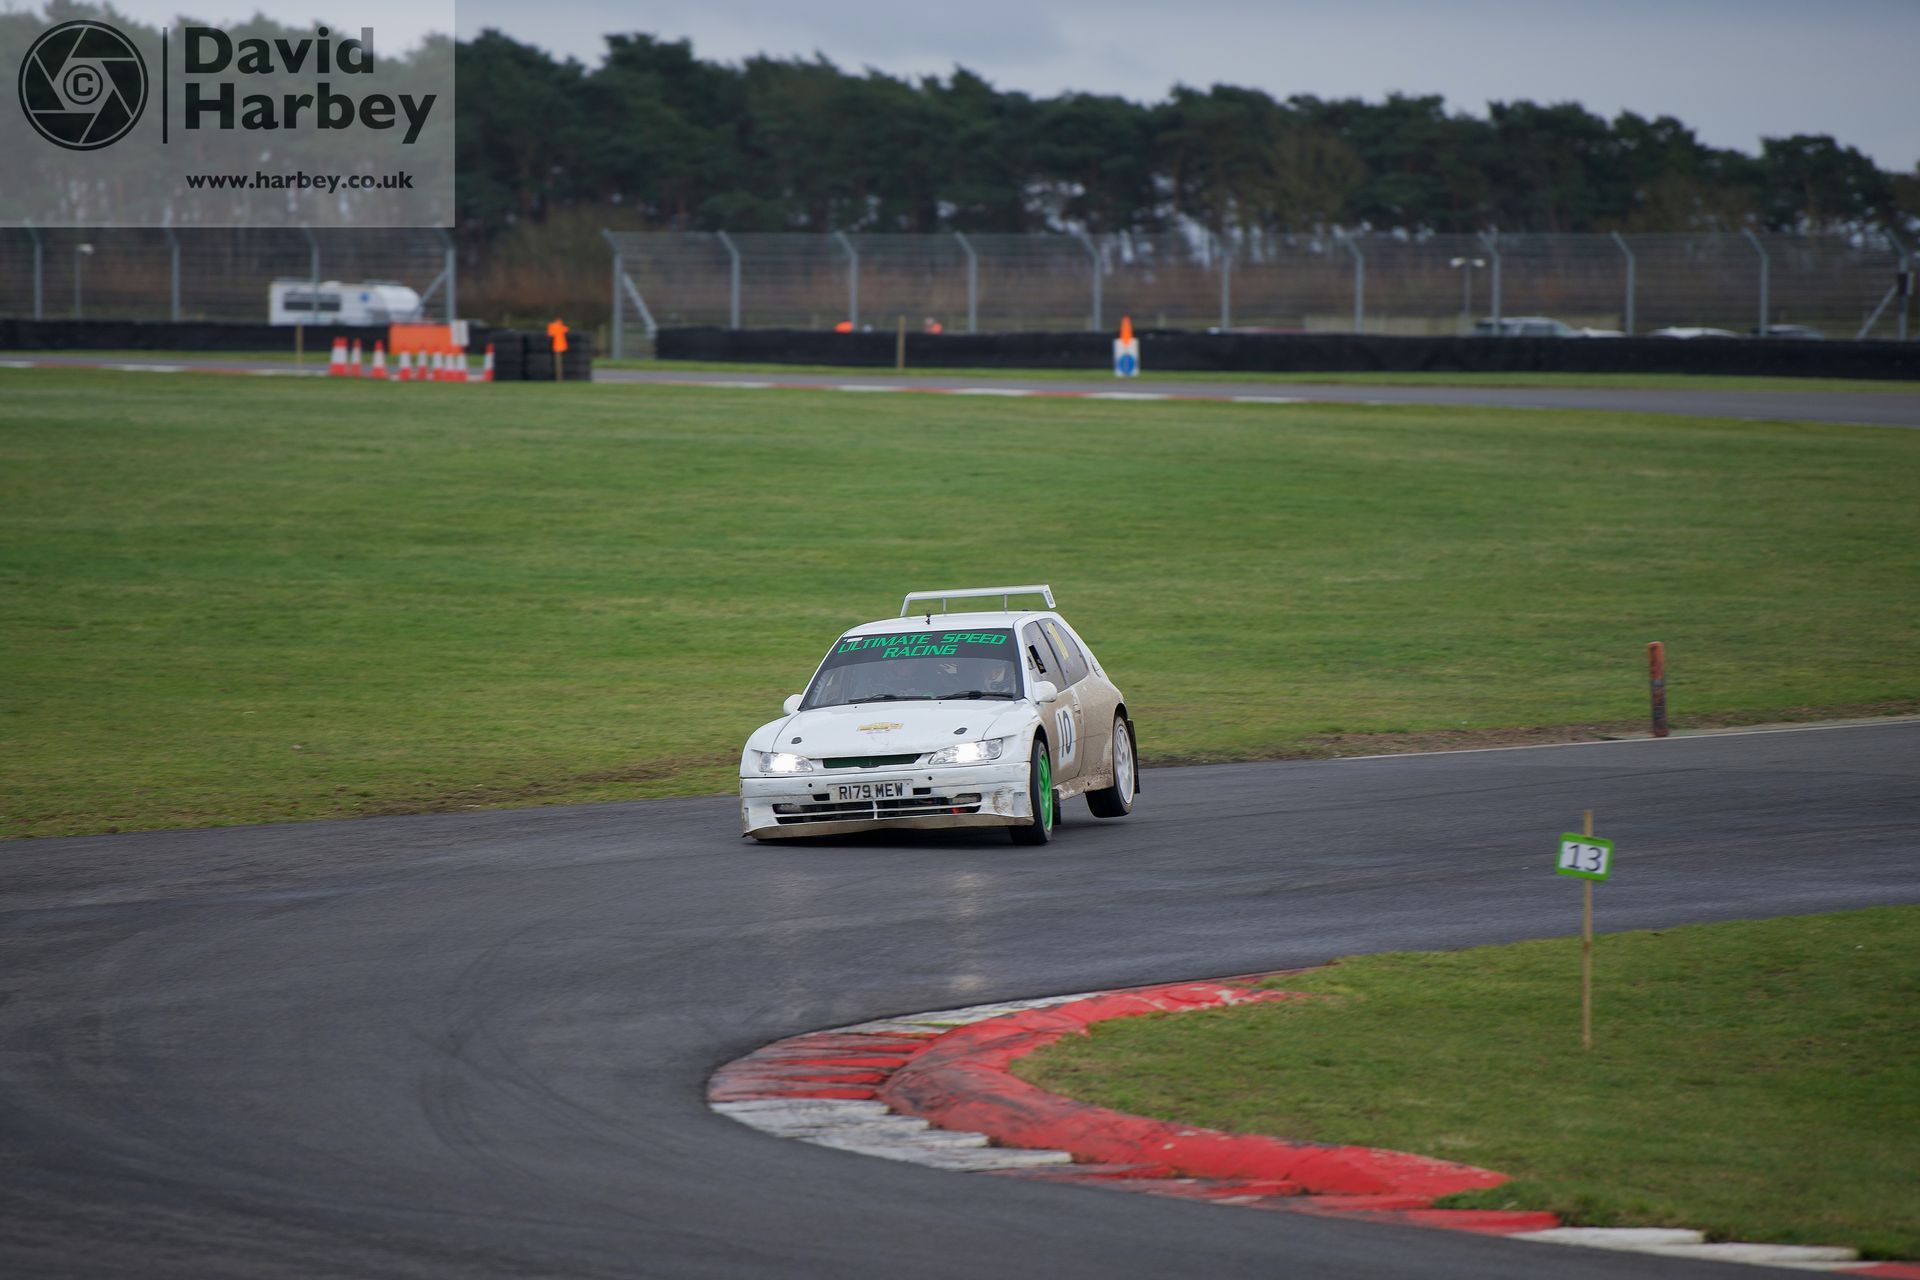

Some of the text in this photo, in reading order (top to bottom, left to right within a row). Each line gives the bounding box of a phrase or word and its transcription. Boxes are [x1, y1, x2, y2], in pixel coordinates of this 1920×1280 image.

[837, 633, 1008, 654] ULTIMATE SPEED
[882, 644, 958, 659] RACING
[1057, 710, 1072, 758] 10
[839, 783, 903, 800] R179 MEW
[1567, 844, 1603, 872] 13
